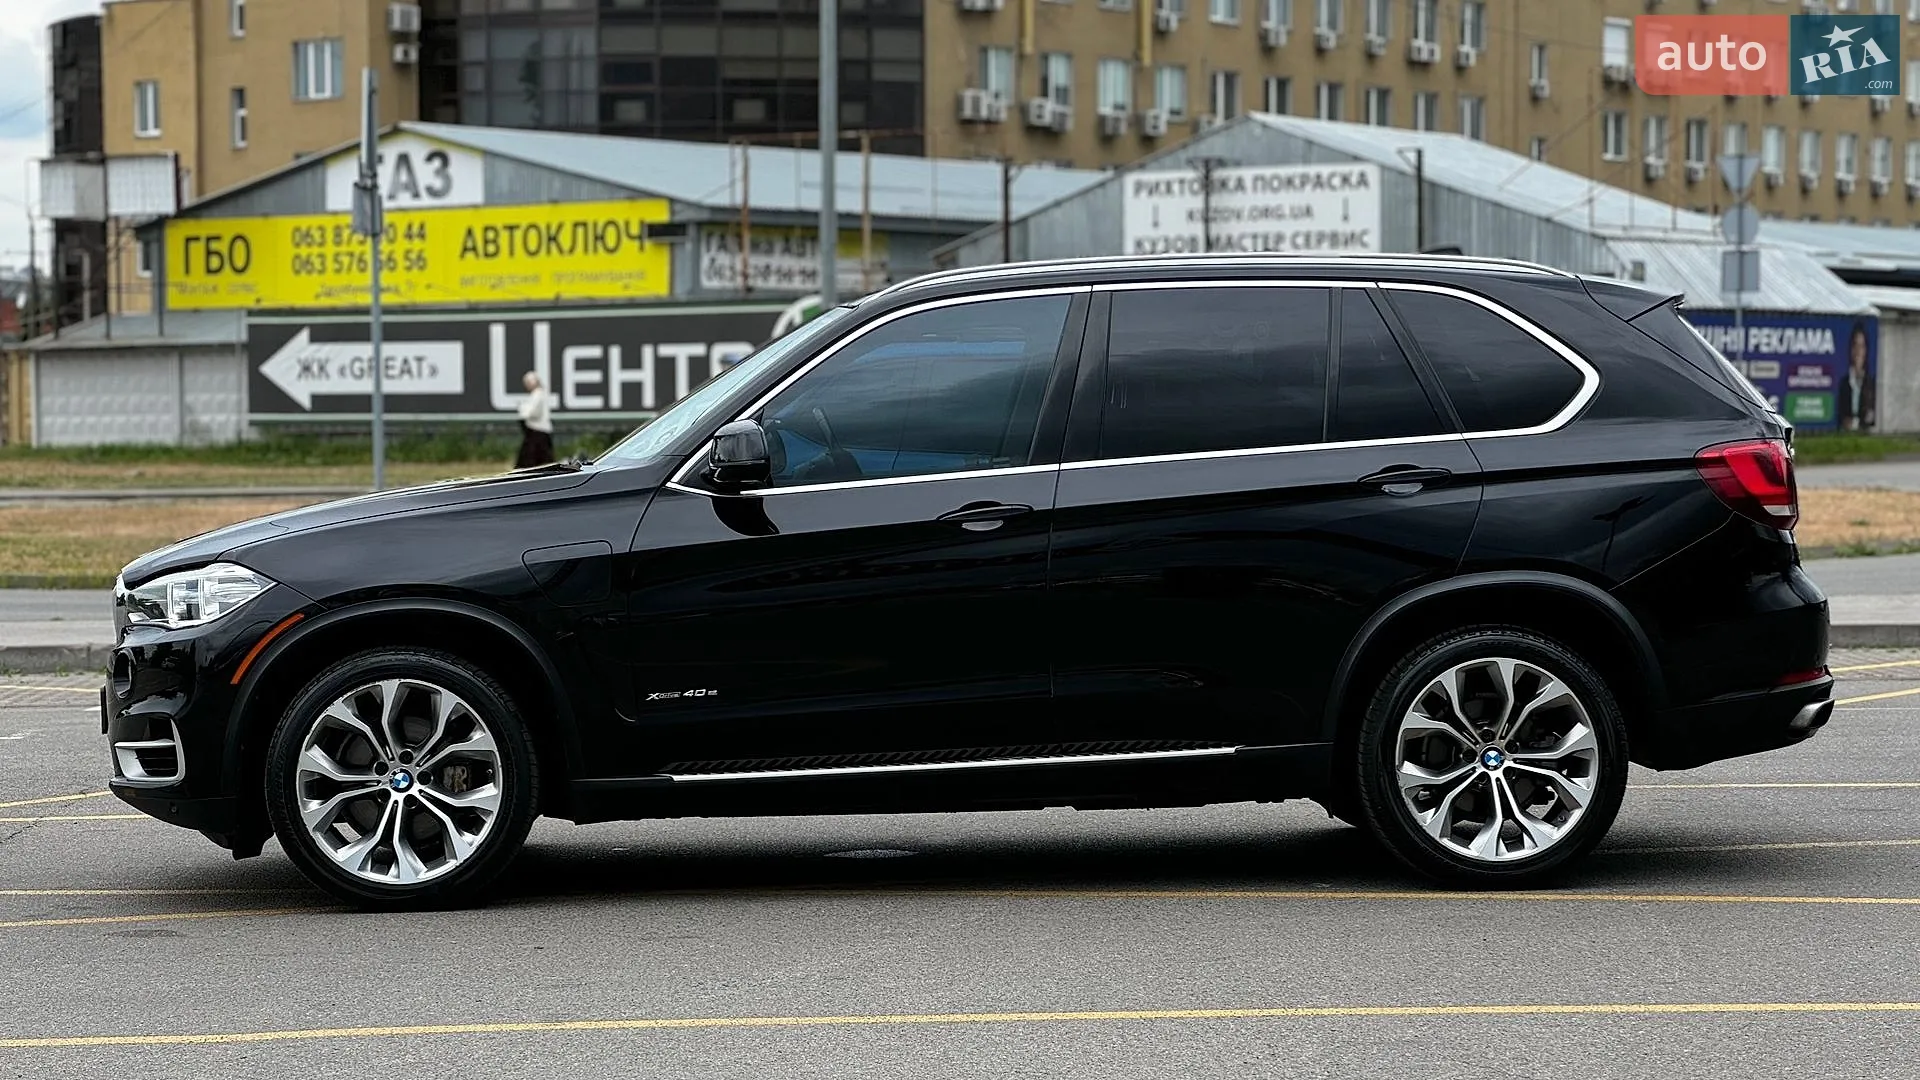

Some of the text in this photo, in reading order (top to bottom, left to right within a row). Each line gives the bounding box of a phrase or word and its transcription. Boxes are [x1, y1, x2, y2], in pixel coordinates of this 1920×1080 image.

[376, 150, 452, 200] АЗ
[1251, 170, 1370, 195] ПОКРАСКА
[291, 226, 326, 248] 063
[403, 220, 427, 242] 44
[459, 219, 646, 262] АВТОКЛЮЧ
[1290, 228, 1371, 251] СЕРВИС
[184, 235, 251, 275] ГБО
[291, 253, 327, 275] 063
[332, 250, 368, 274] 576
[403, 247, 428, 272] 56
[1748, 324, 1835, 354] РЕКЛАМА
[297, 356, 330, 381] ЖК
